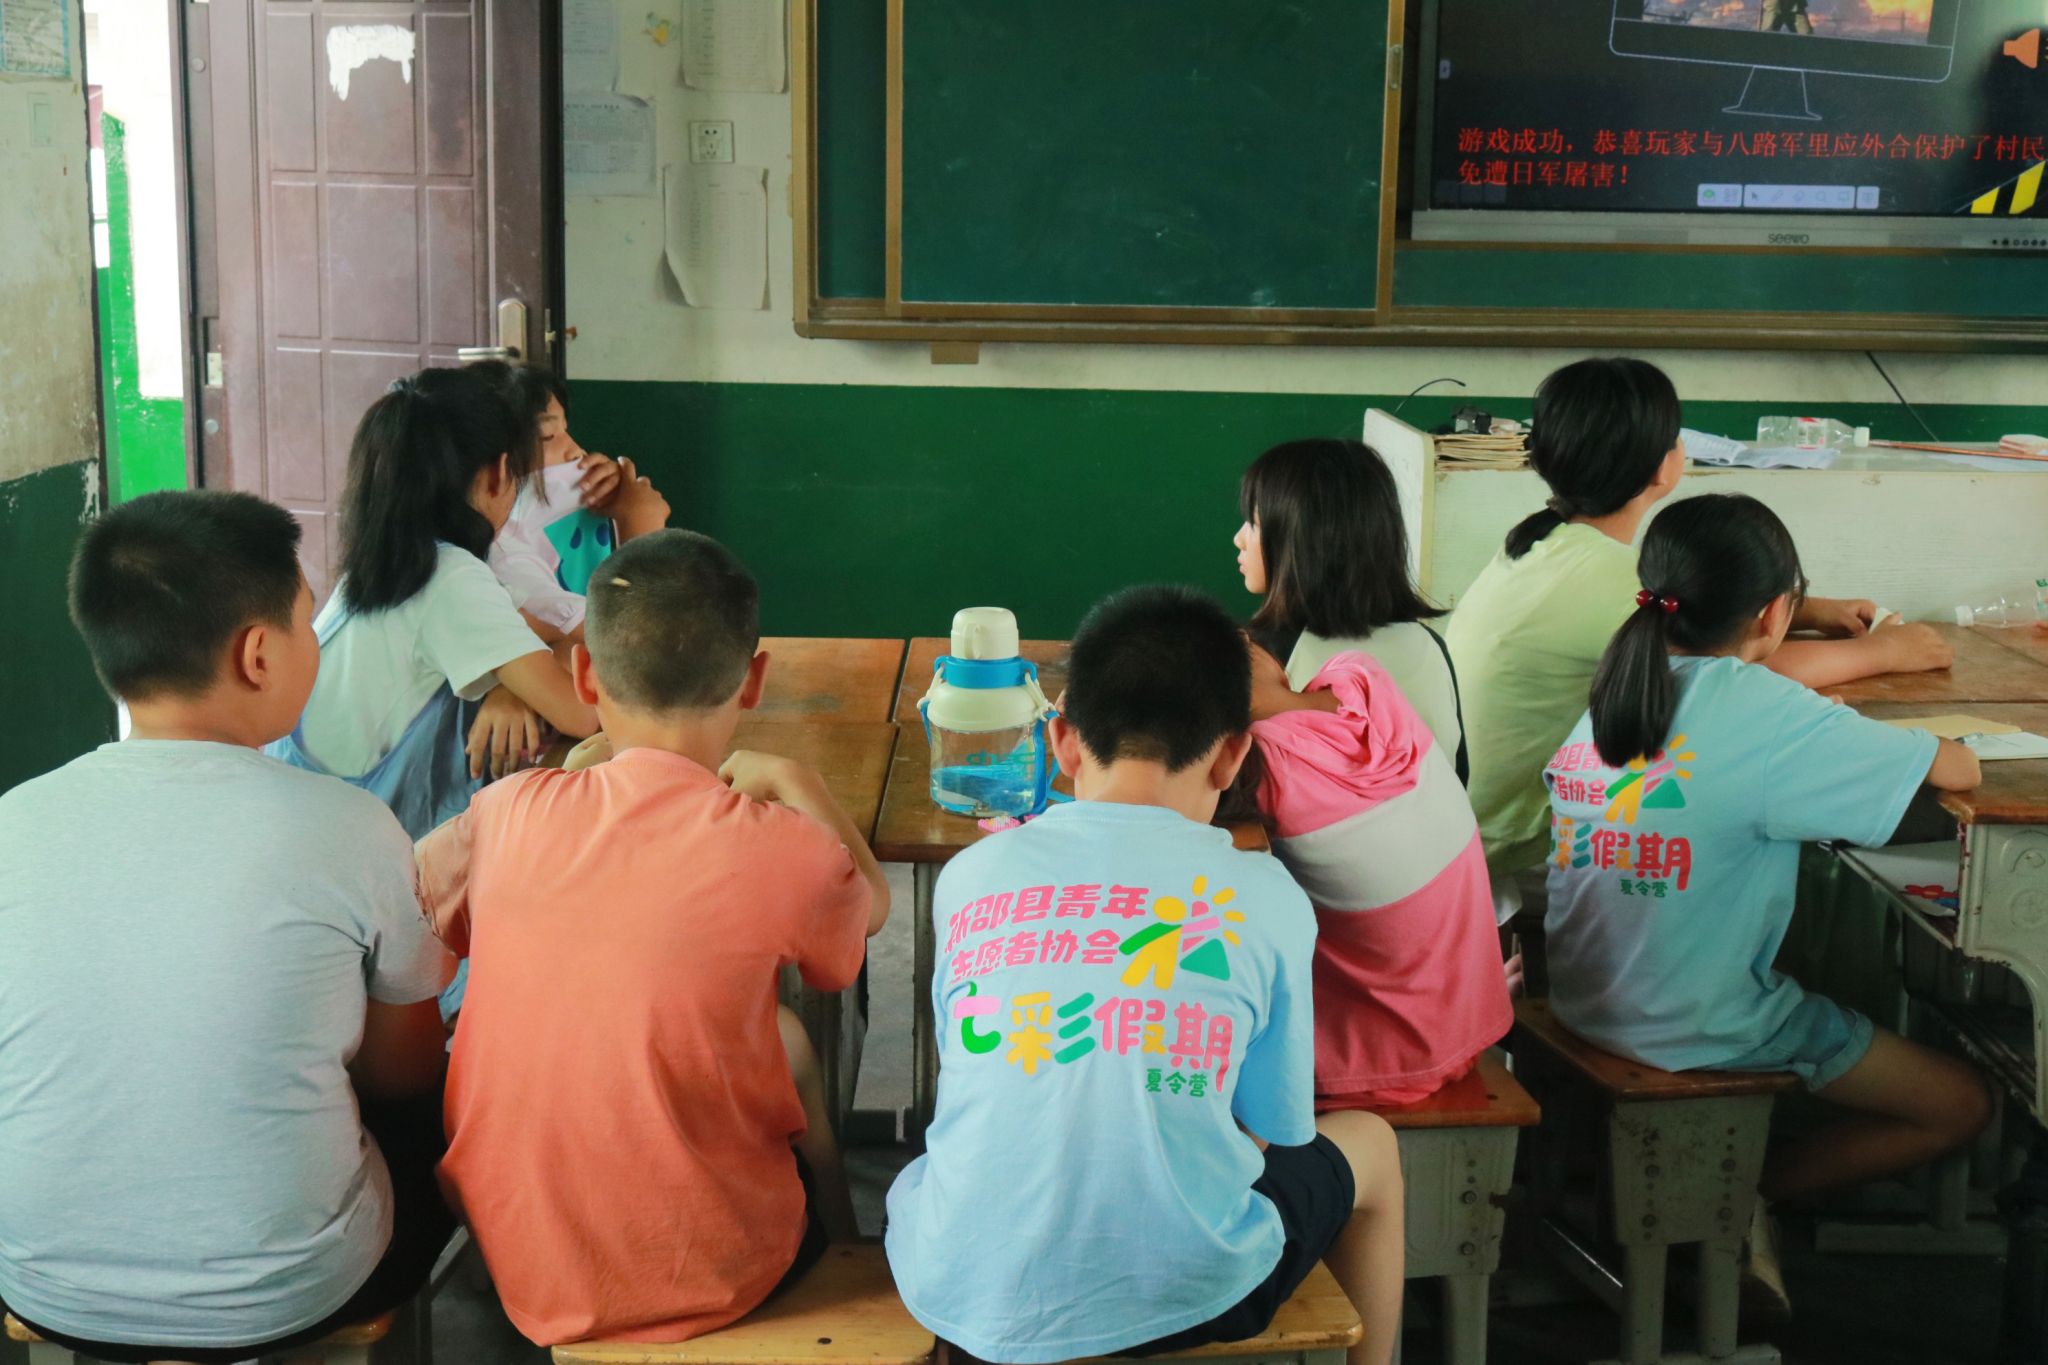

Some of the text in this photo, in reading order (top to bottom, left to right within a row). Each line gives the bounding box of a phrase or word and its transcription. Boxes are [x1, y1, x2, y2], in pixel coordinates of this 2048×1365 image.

[1551, 815, 1691, 891] 彩假期
[1619, 878, 1668, 898] 夏令营
[953, 981, 1233, 1093] 七彩假期
[1145, 1068, 1208, 1097] 夏令营
